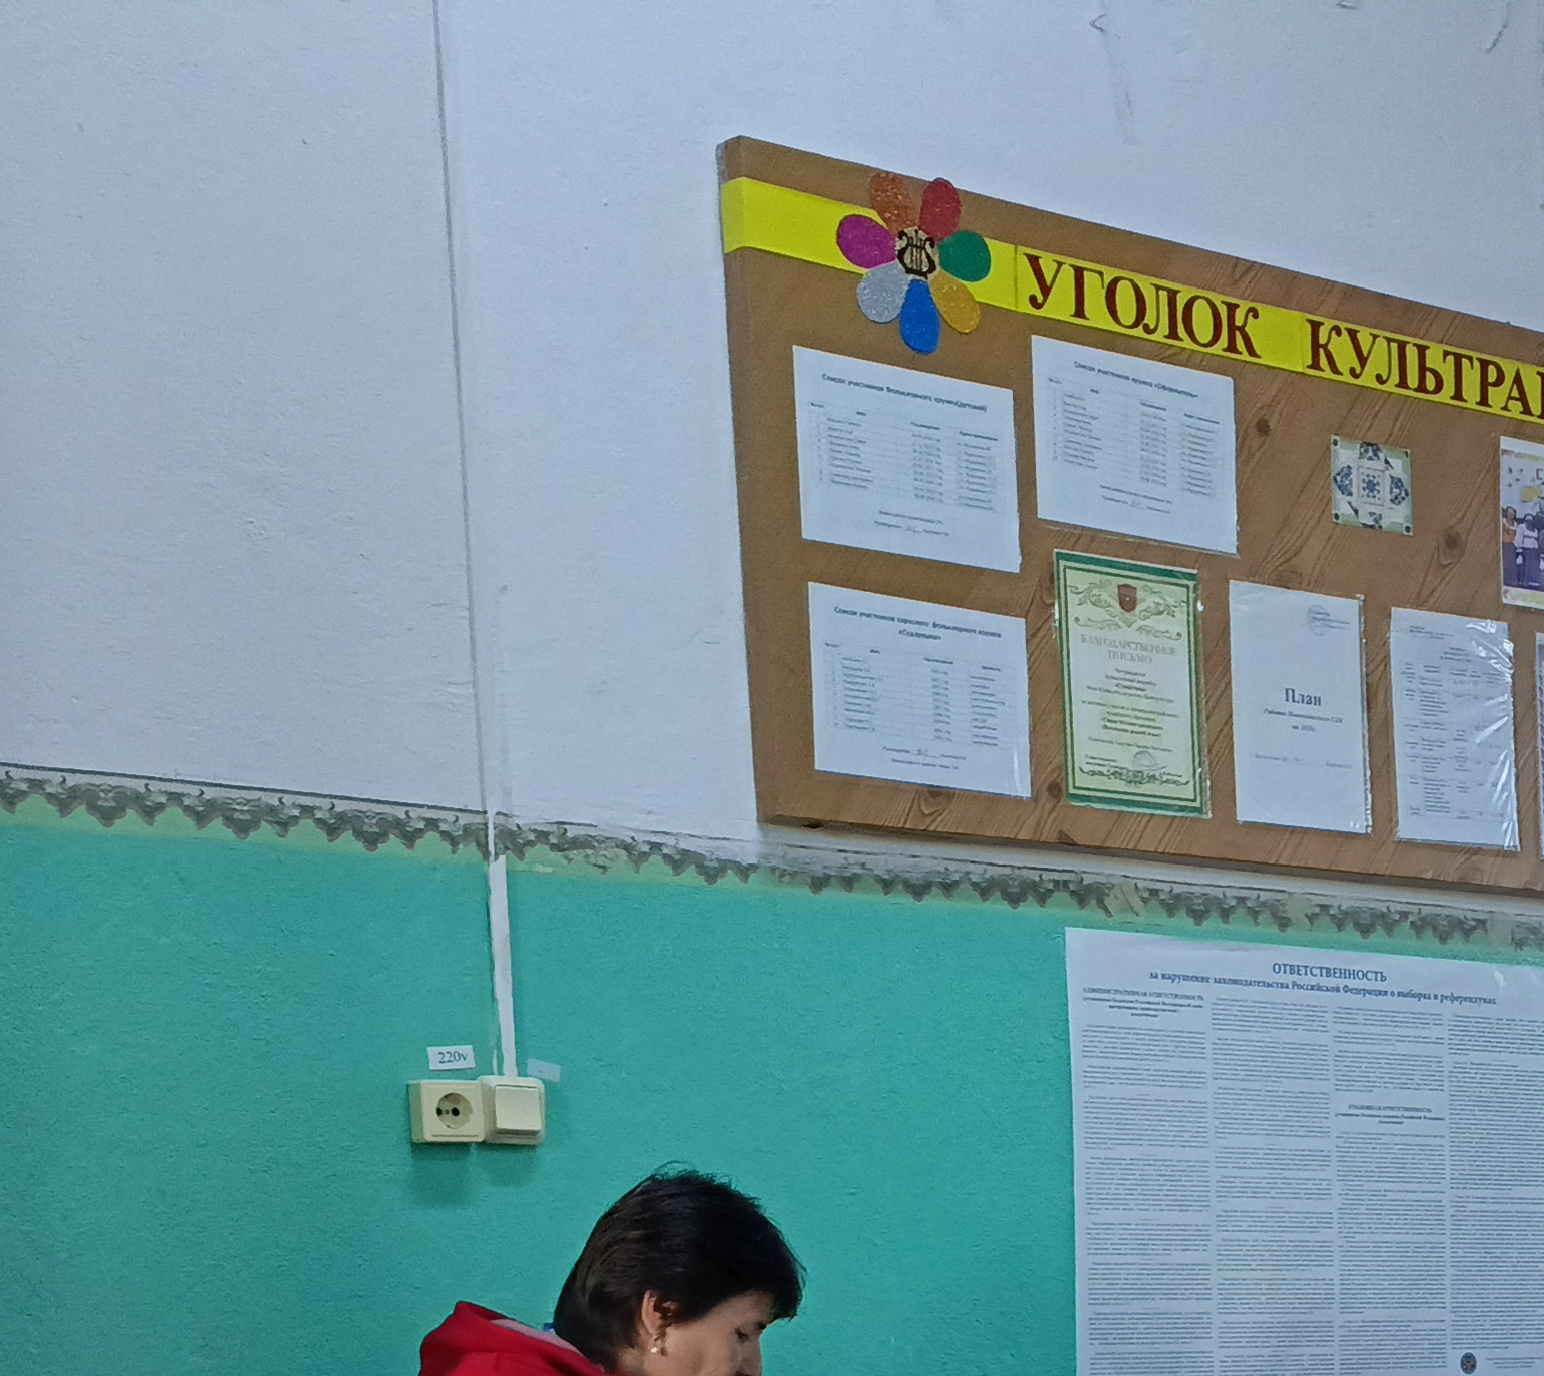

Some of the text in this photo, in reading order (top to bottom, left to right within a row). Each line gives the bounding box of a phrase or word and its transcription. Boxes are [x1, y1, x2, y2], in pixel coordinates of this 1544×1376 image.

[1023, 252, 1262, 360] УГОЛОК
[1284, 687, 1322, 707] План
[1272, 962, 1387, 982] ОТВЕТСТВЕННОСТЬ
[1161, 973, 1210, 984] нарушение
[1213, 976, 1289, 990] законодательства
[1291, 981, 1341, 994] Российской
[1342, 984, 1388, 998] Федерации
[437, 1051, 468, 1064] 220v
